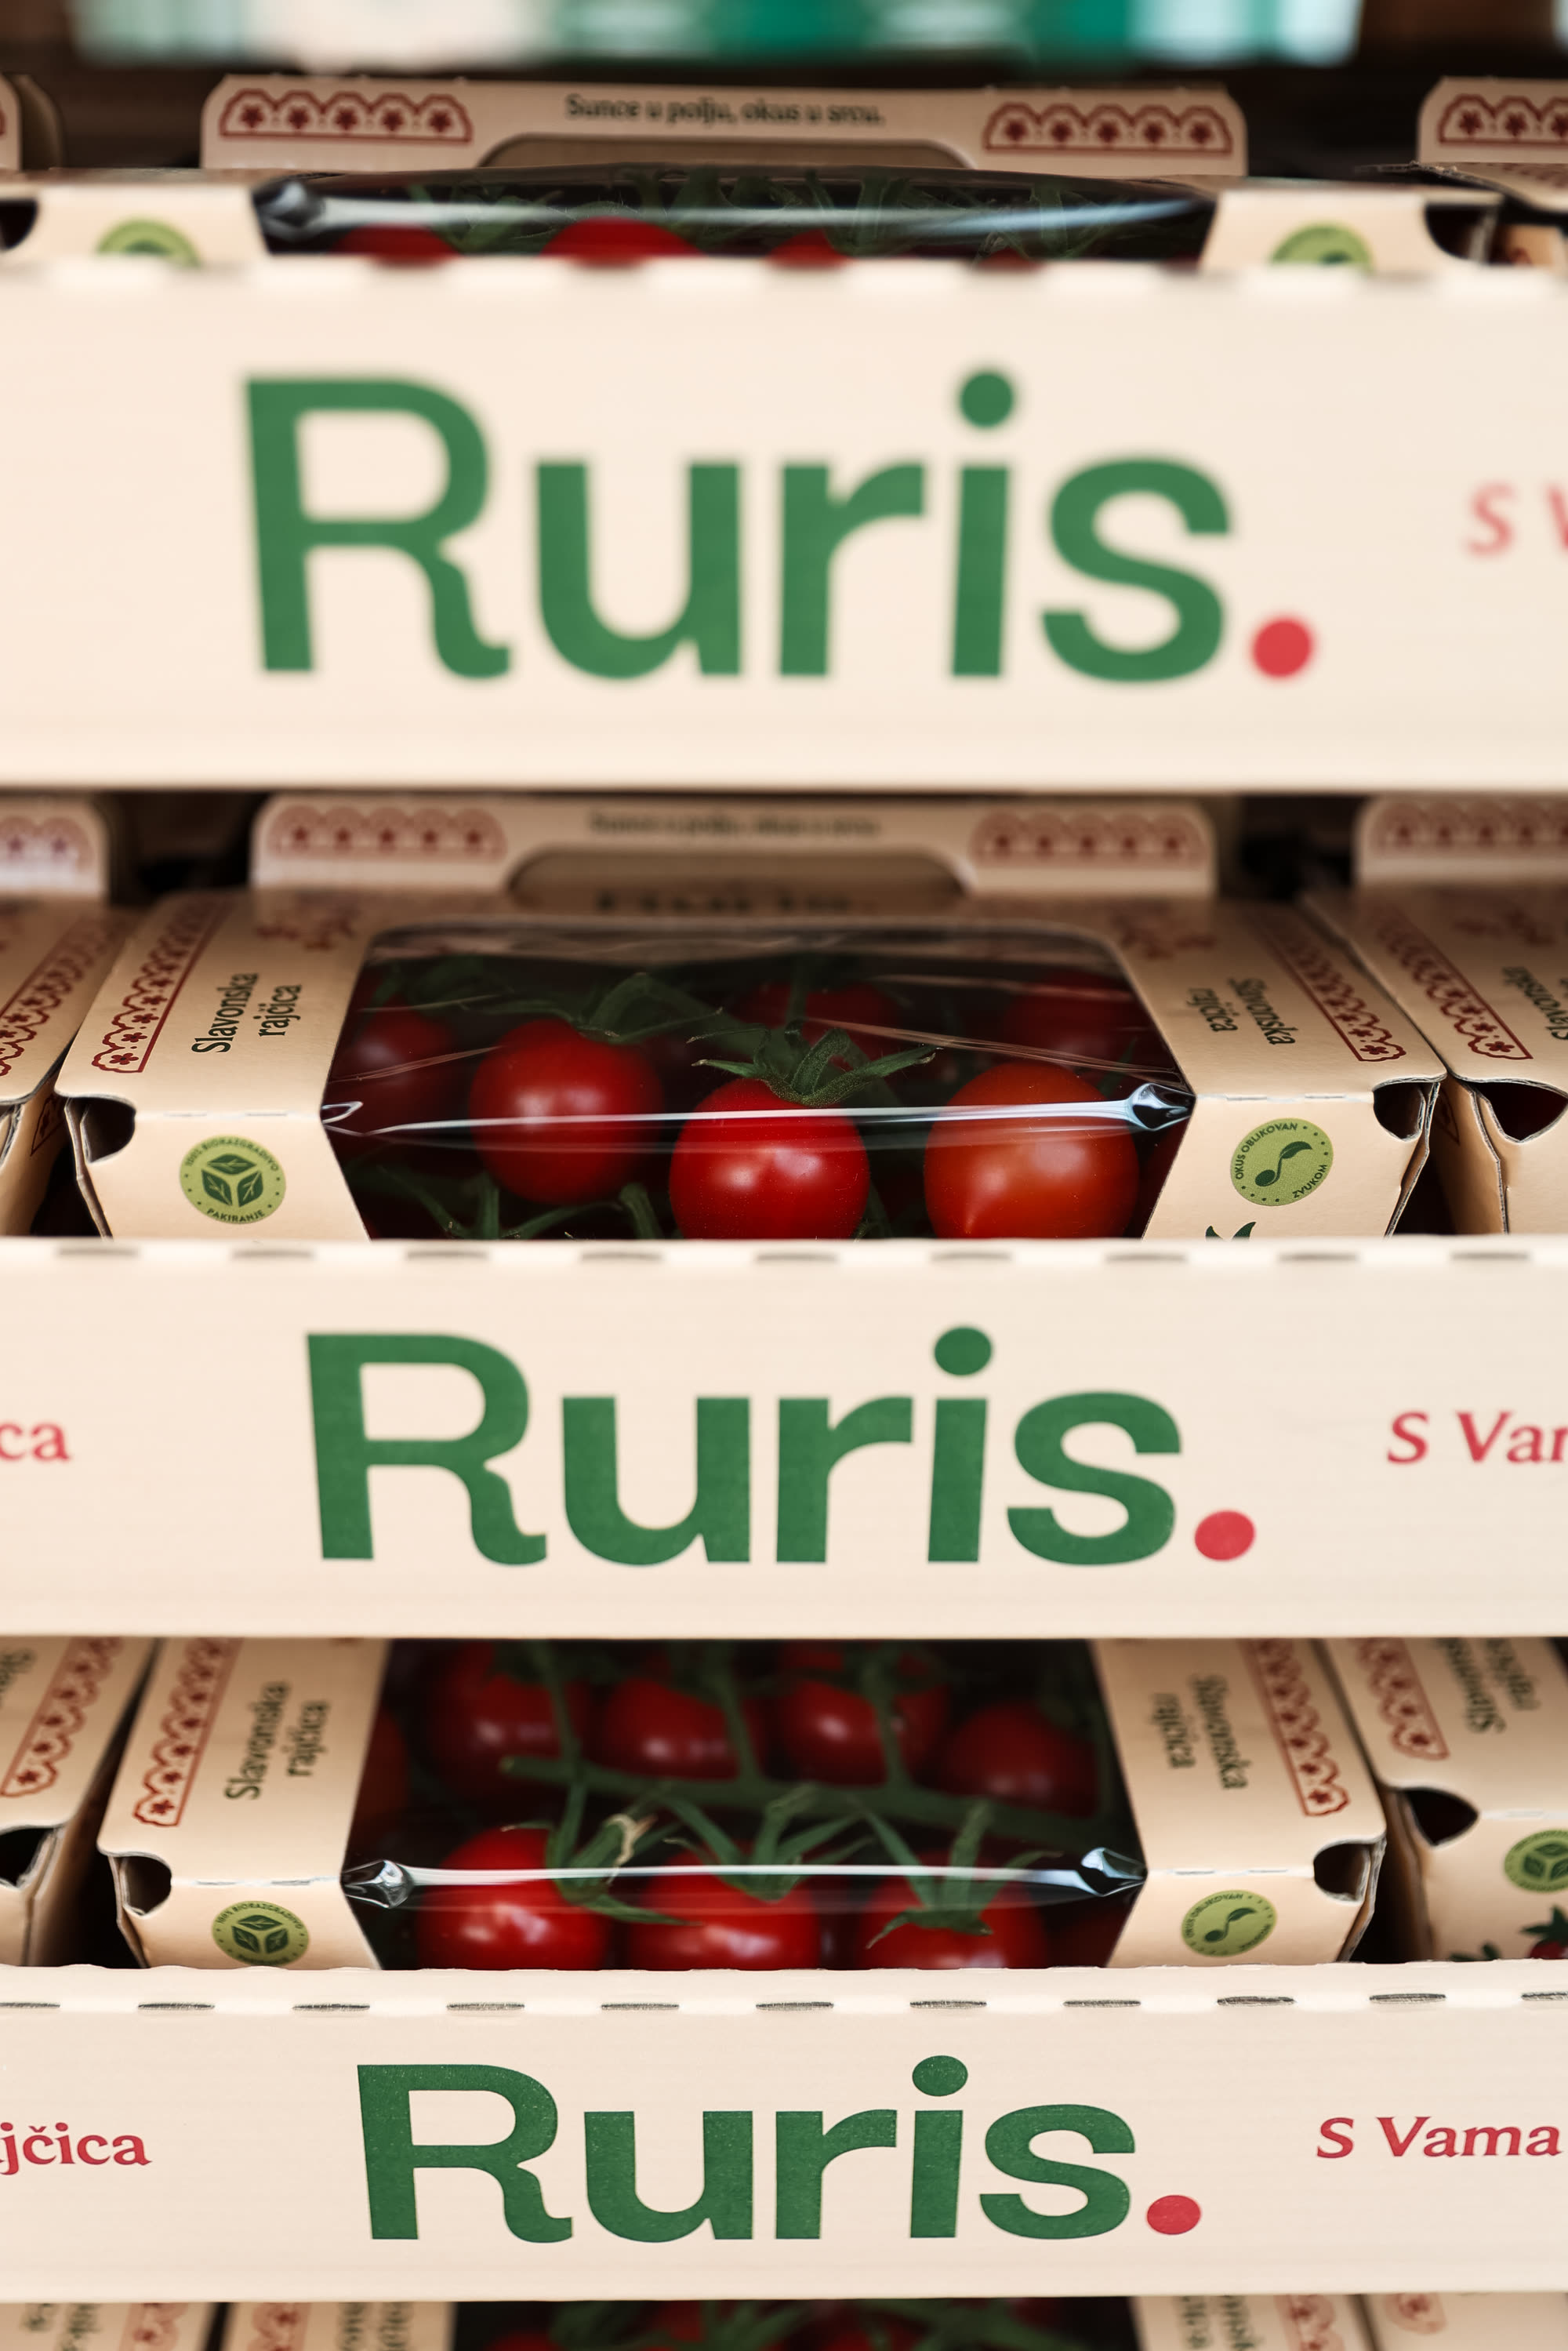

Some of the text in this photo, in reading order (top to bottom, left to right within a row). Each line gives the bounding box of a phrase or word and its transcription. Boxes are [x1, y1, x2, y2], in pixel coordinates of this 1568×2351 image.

[565, 93, 641, 119] Sunce
[645, 100, 662, 121] u
[740, 97, 800, 124] okus
[804, 104, 822, 124] u
[246, 371, 1317, 683] Ruris.
[191, 973, 259, 1053] Slavonska
[253, 984, 302, 1037] rajčica
[1235, 1122, 1298, 1180] OKUS OBLIKOVAN
[1292, 1164, 1328, 1198] ZVUKOM
[207, 1208, 265, 1223] PAKIRANJE
[308, 1327, 1258, 1566] Ruris.
[1386, 1410, 1429, 1465] S
[223, 1681, 291, 1799] Slavonska
[0, 2121, 152, 2175] jčica
[357, 2055, 1202, 2243] Ruris.
[1316, 2116, 1563, 2159] S Vama
